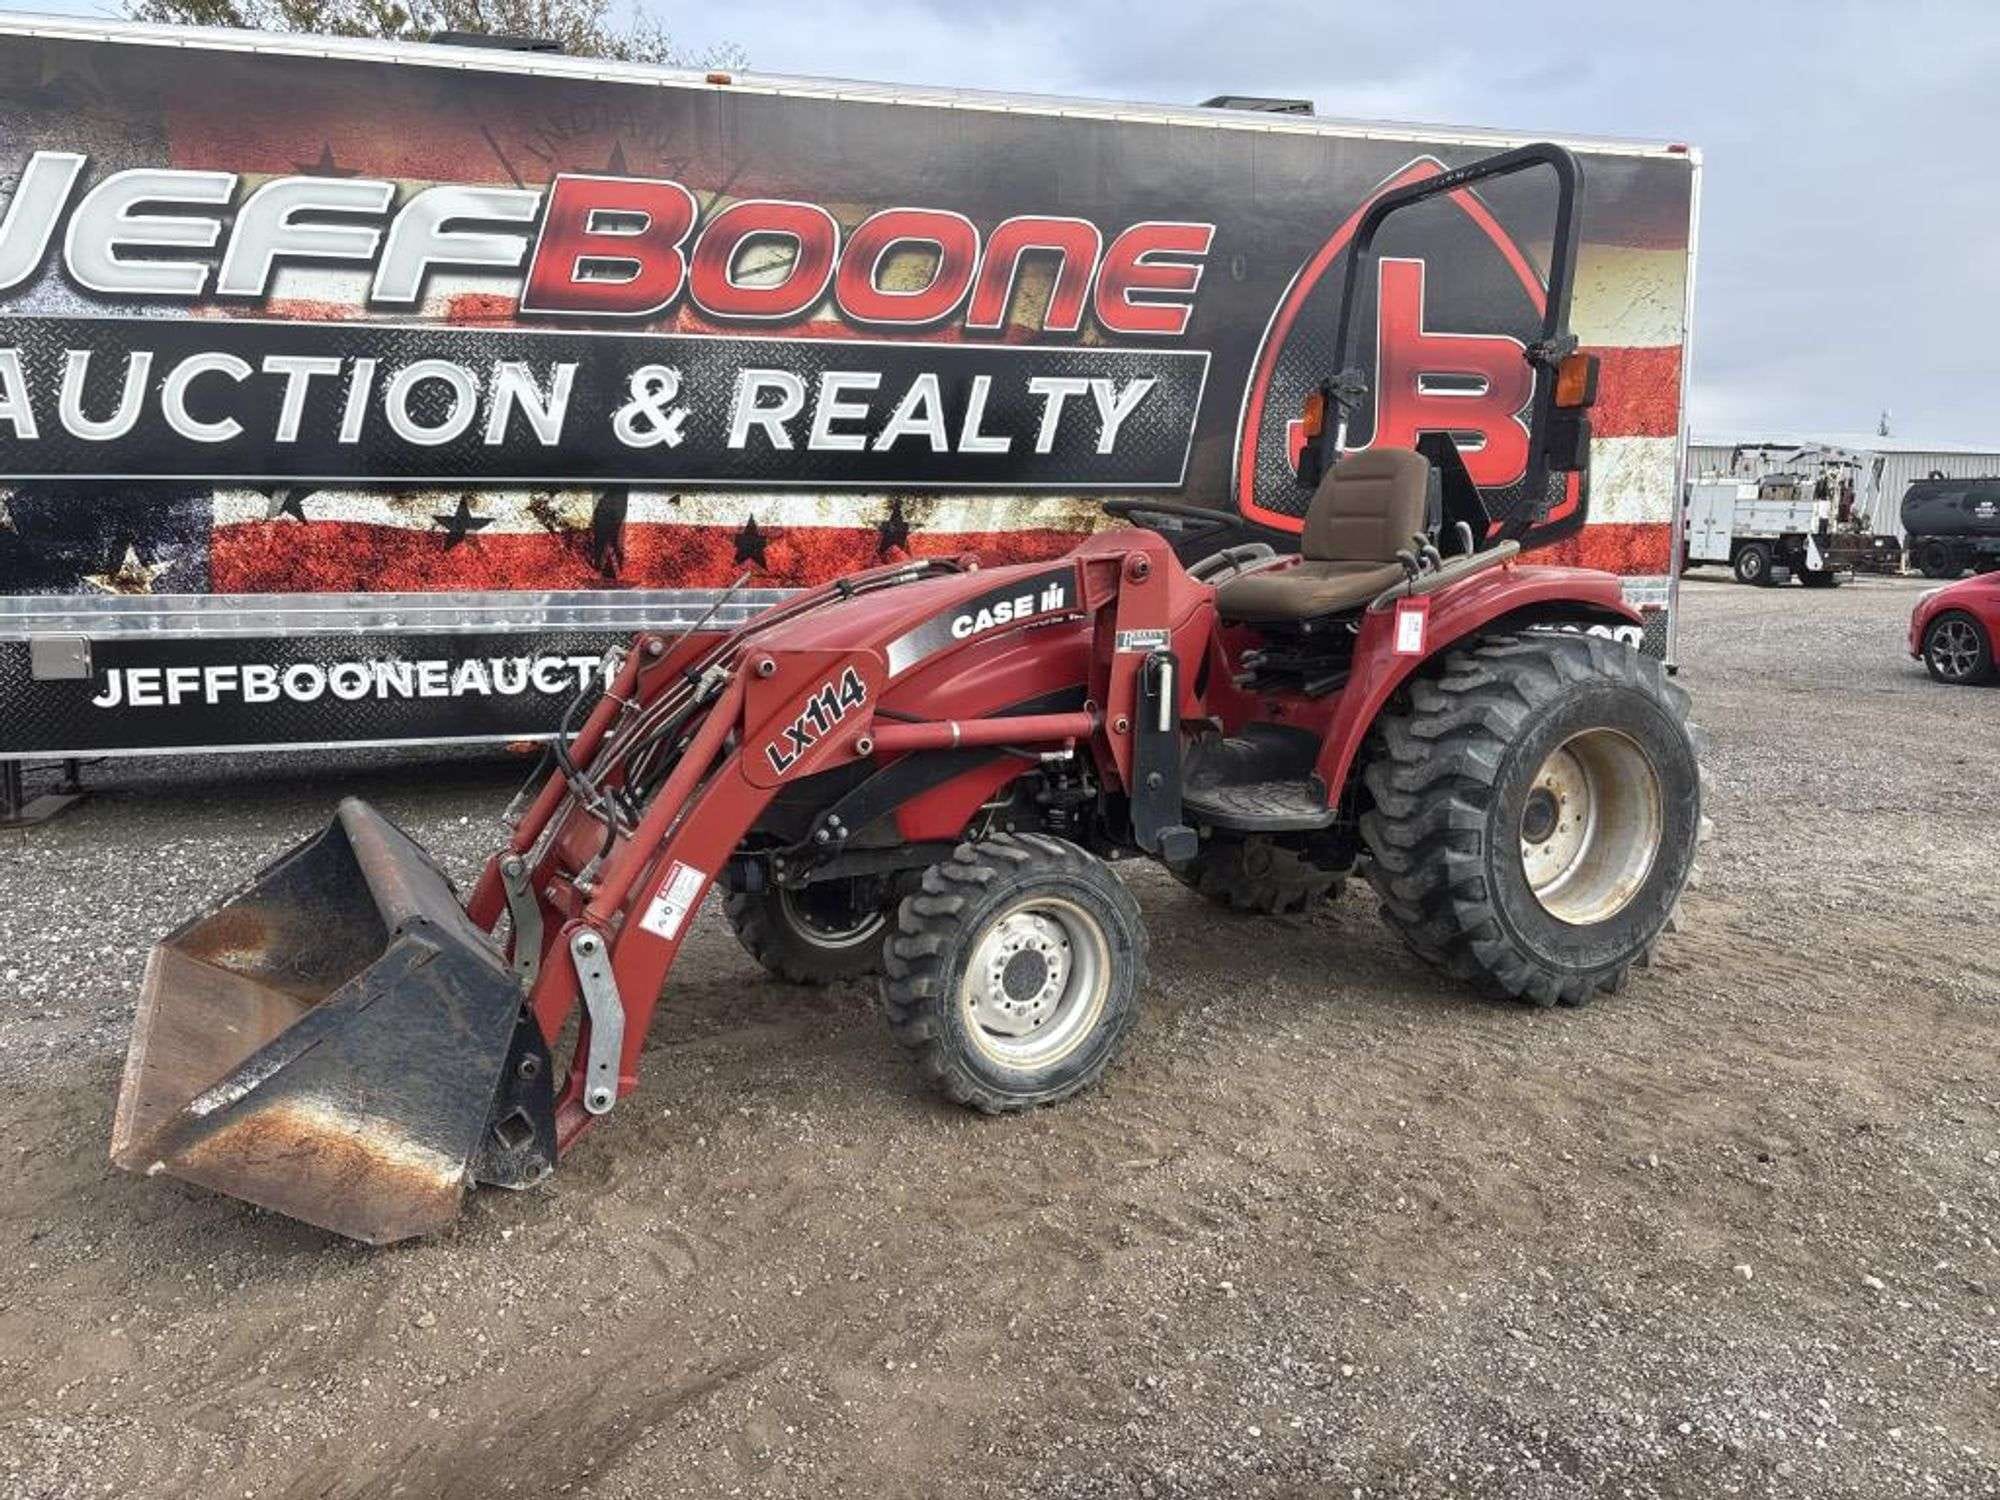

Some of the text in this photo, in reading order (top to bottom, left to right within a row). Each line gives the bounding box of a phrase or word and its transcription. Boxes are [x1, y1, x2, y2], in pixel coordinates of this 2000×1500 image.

[612, 364, 688, 450] &
[727, 367, 1158, 455] REALTY
[951, 594, 1035, 639] CASE
[765, 665, 866, 776] LX114
